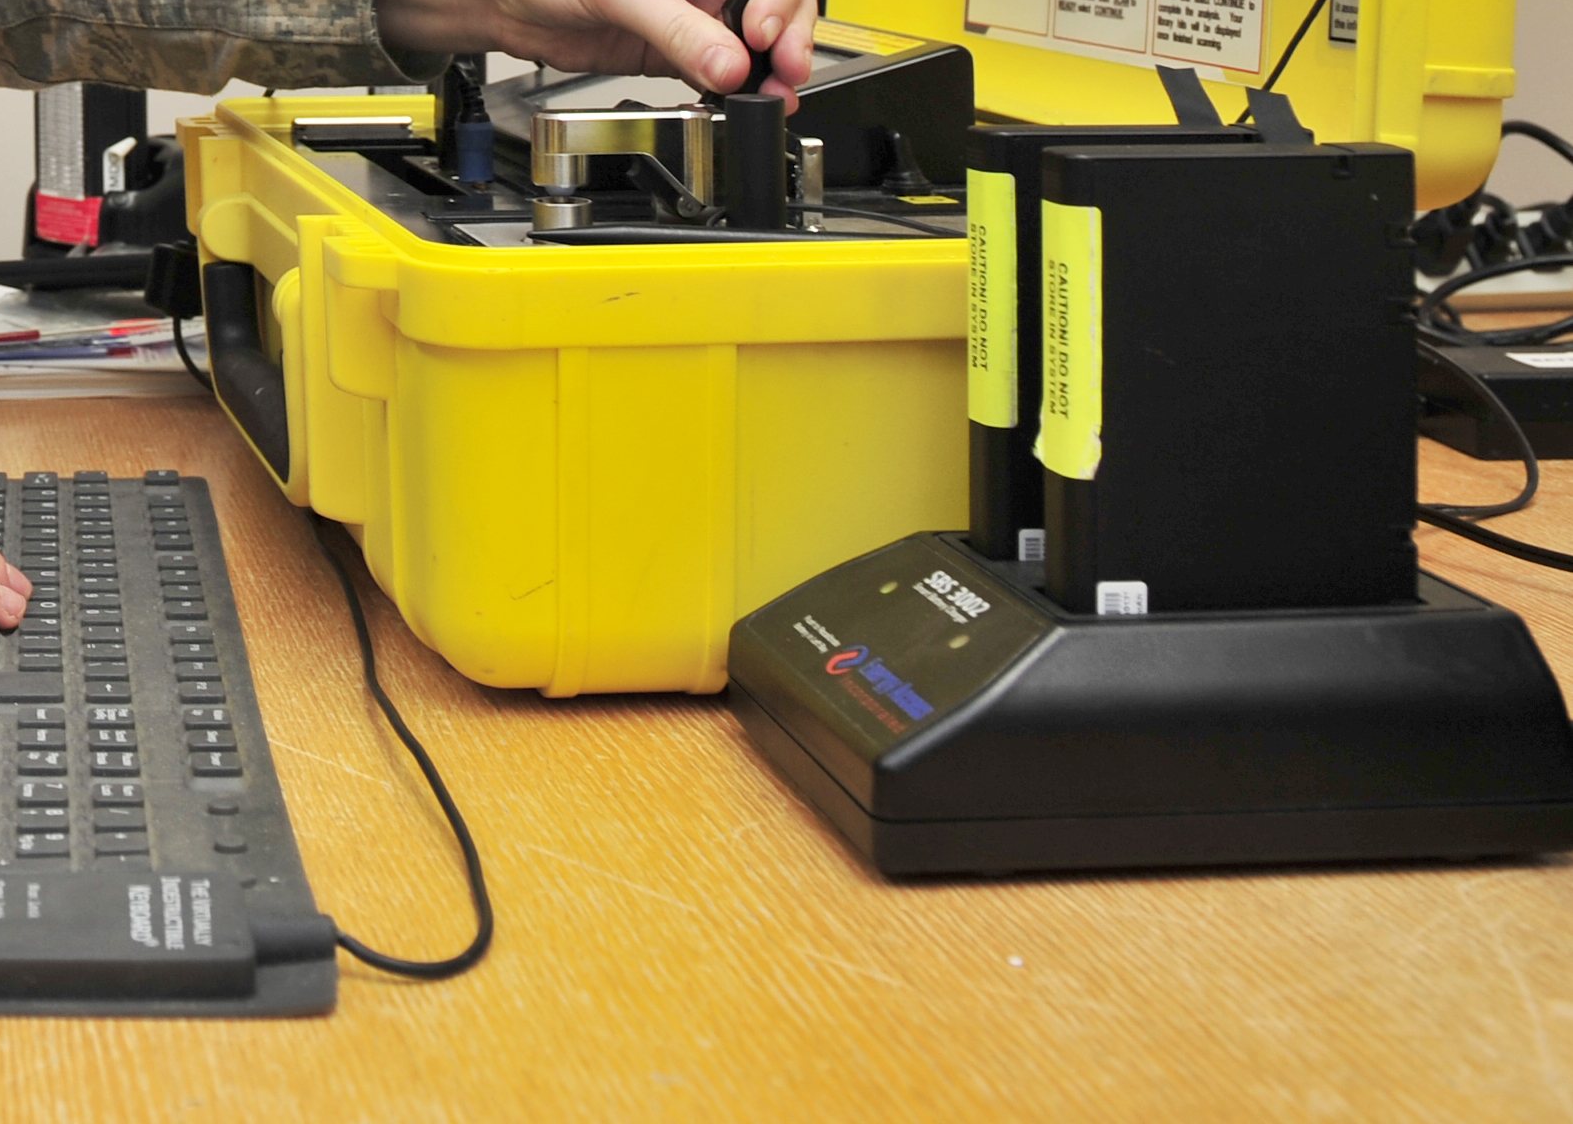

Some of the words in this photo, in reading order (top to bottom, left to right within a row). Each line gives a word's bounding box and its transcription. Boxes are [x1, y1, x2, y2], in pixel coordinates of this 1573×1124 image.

[1058, 0, 1076, 12] READY
[1158, 4, 1181, 14] complete
[1185, 6, 1193, 16] the
[1198, 9, 1220, 21] analysis.
[1230, 12, 1243, 23] Your
[1249, 1, 1255, 11] to
[1173, 32, 1193, 44] finished
[1197, 37, 1222, 51] scanning.
[1215, 25, 1241, 39] displayed
[971, 282, 976, 297] IN
[980, 312, 988, 332] DO
[1049, 322, 1056, 339] IN
[980, 338, 989, 372] NOT
[1059, 352, 1069, 376] DO
[1049, 347, 1057, 415] SYSTEM
[1059, 383, 1069, 419] NOT
[923, 570, 960, 594] SBS
[945, 585, 991, 617] 3002
[190, 880, 211, 898] THE
[160, 876, 184, 950] INDESTRUCTIBLE
[192, 900, 213, 946] VIRTUALLY
